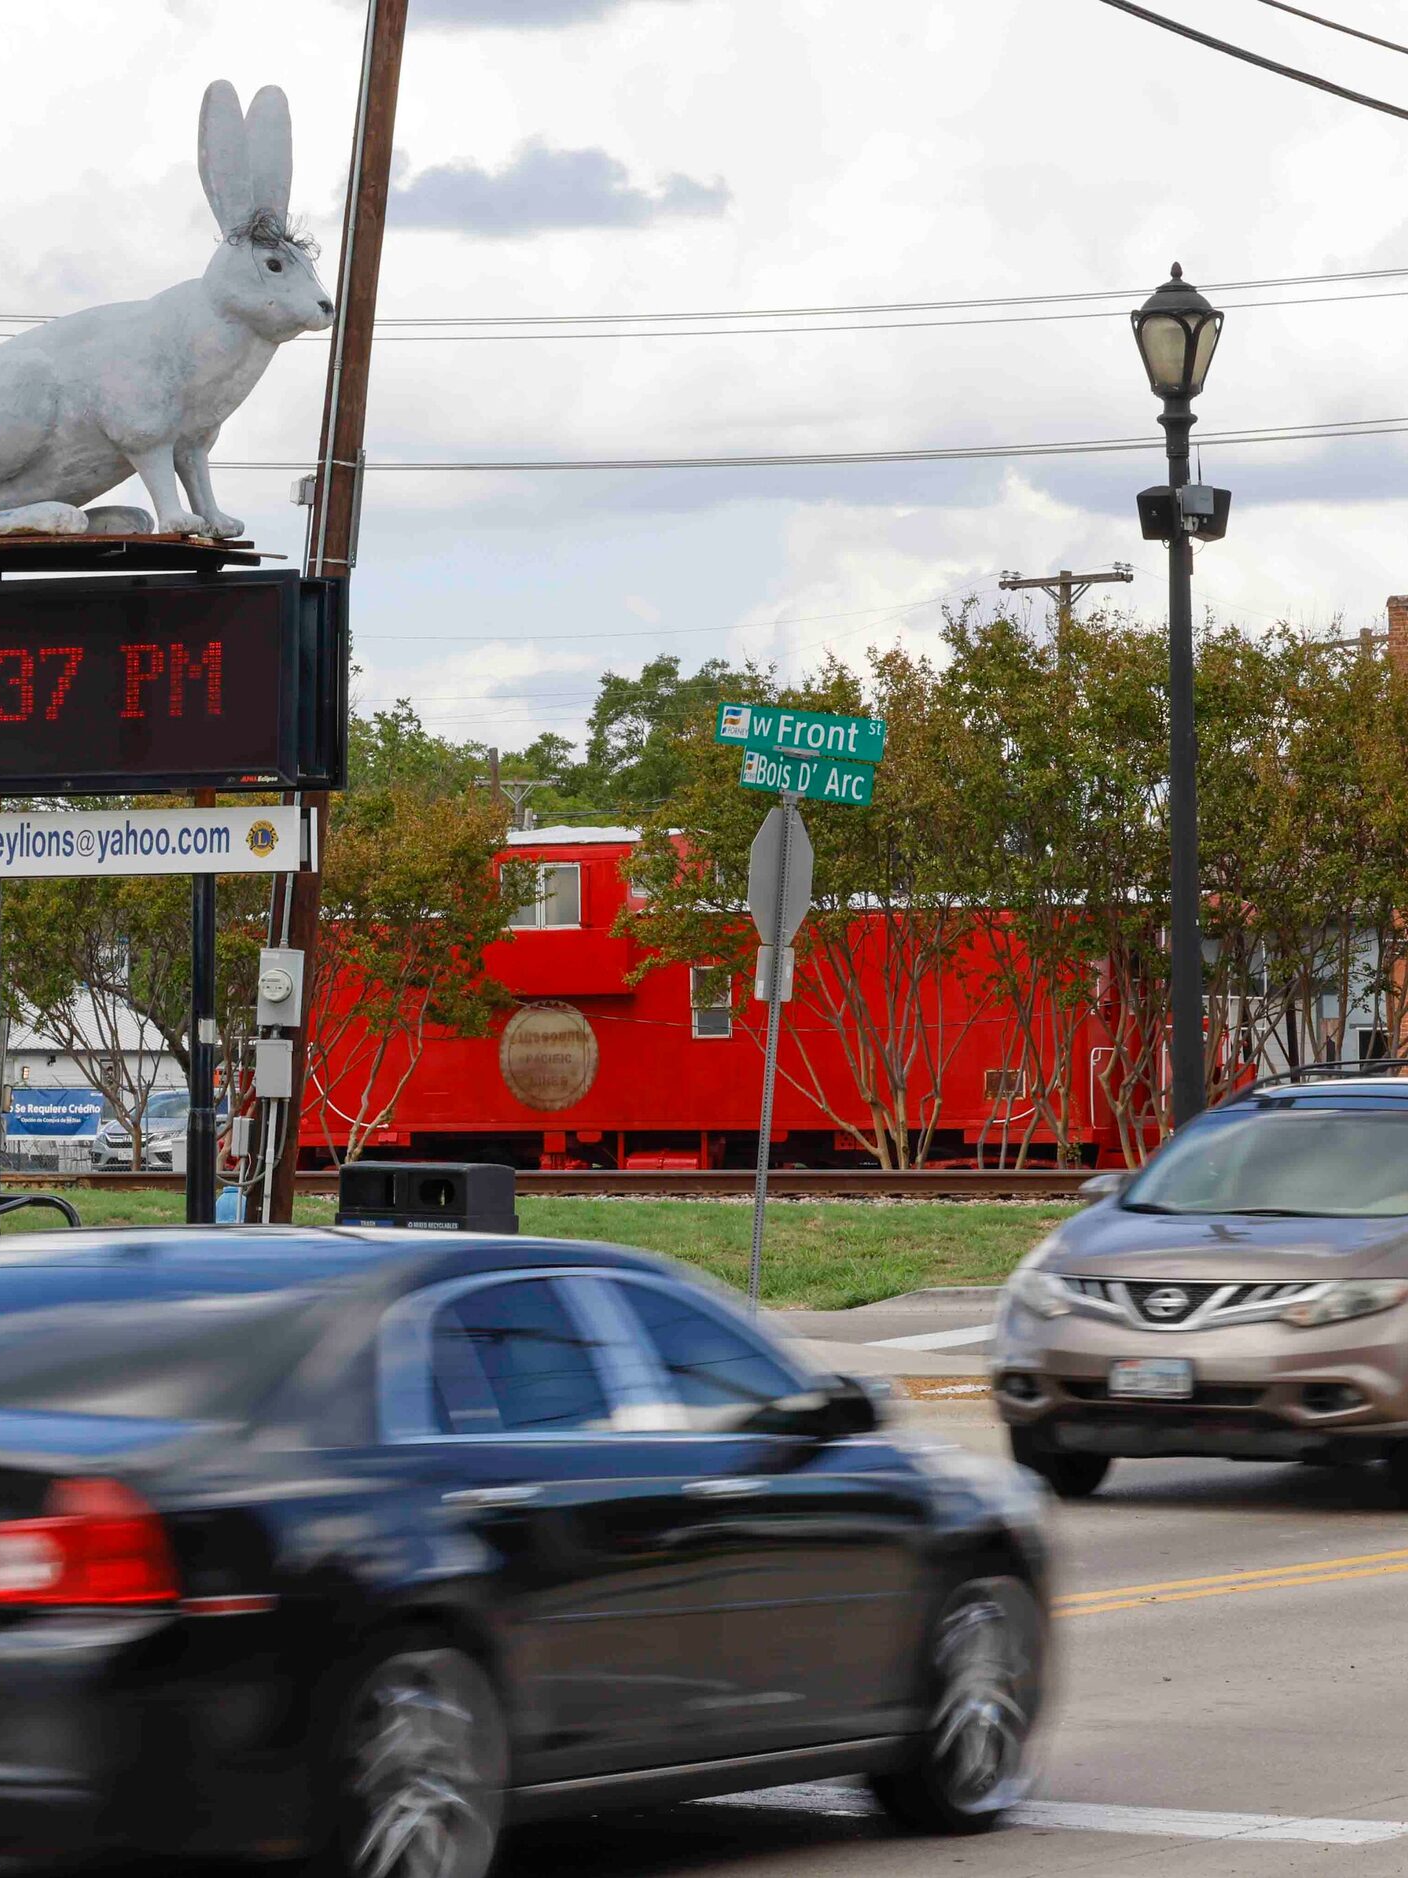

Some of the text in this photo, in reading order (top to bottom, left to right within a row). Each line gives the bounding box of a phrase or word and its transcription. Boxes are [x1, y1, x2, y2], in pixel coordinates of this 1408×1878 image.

[119, 641, 223, 719] PM
[753, 714, 882, 753] W Front St
[756, 755, 792, 789] Bois
[824, 767, 865, 800] Arc
[525, 1054, 572, 1064] PACIFIC
[15, 1104, 26, 1113] Se
[27, 1104, 67, 1115] Requiere
[68, 1103, 101, 1113] Crédito
[427, 1222, 458, 1230] RECYCLABLES
